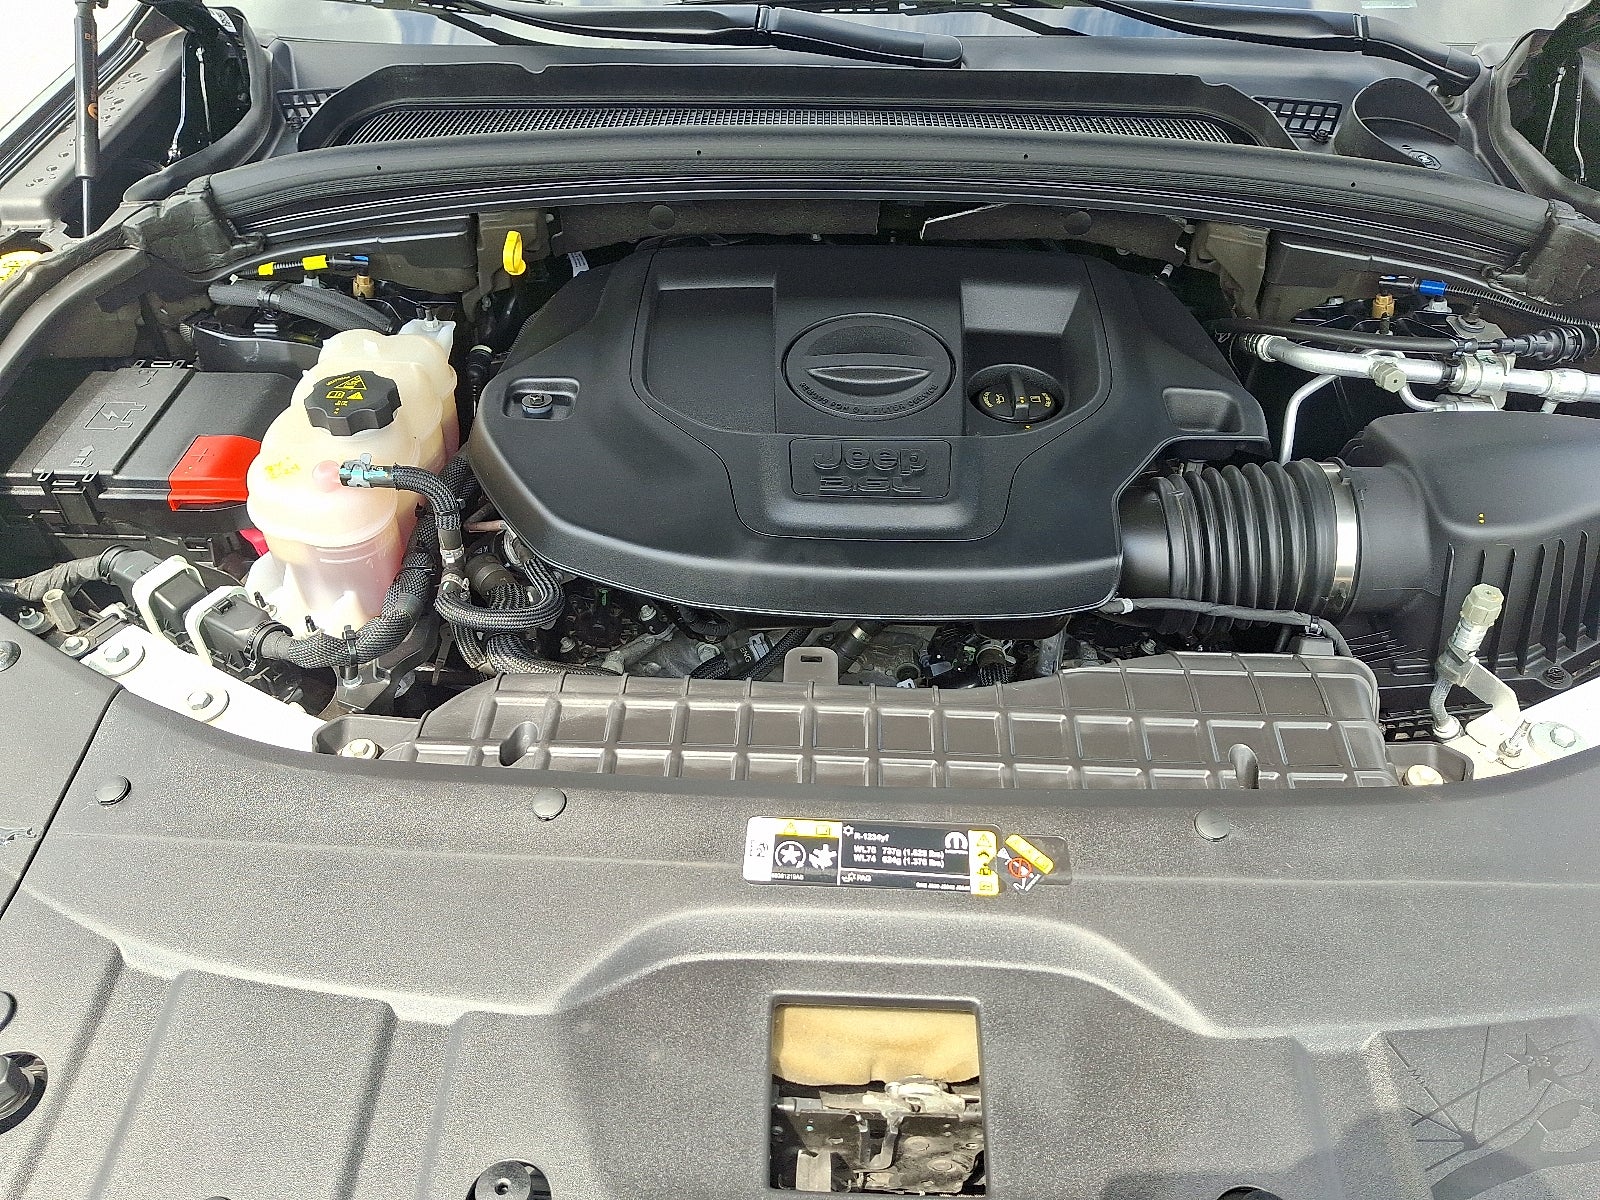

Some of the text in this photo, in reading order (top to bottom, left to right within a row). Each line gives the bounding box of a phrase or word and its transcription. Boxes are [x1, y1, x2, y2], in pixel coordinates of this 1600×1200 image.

[873, 403, 906, 415] FILTER
[812, 441, 928, 476] Jeep
[819, 475, 922, 493] 3.6L
